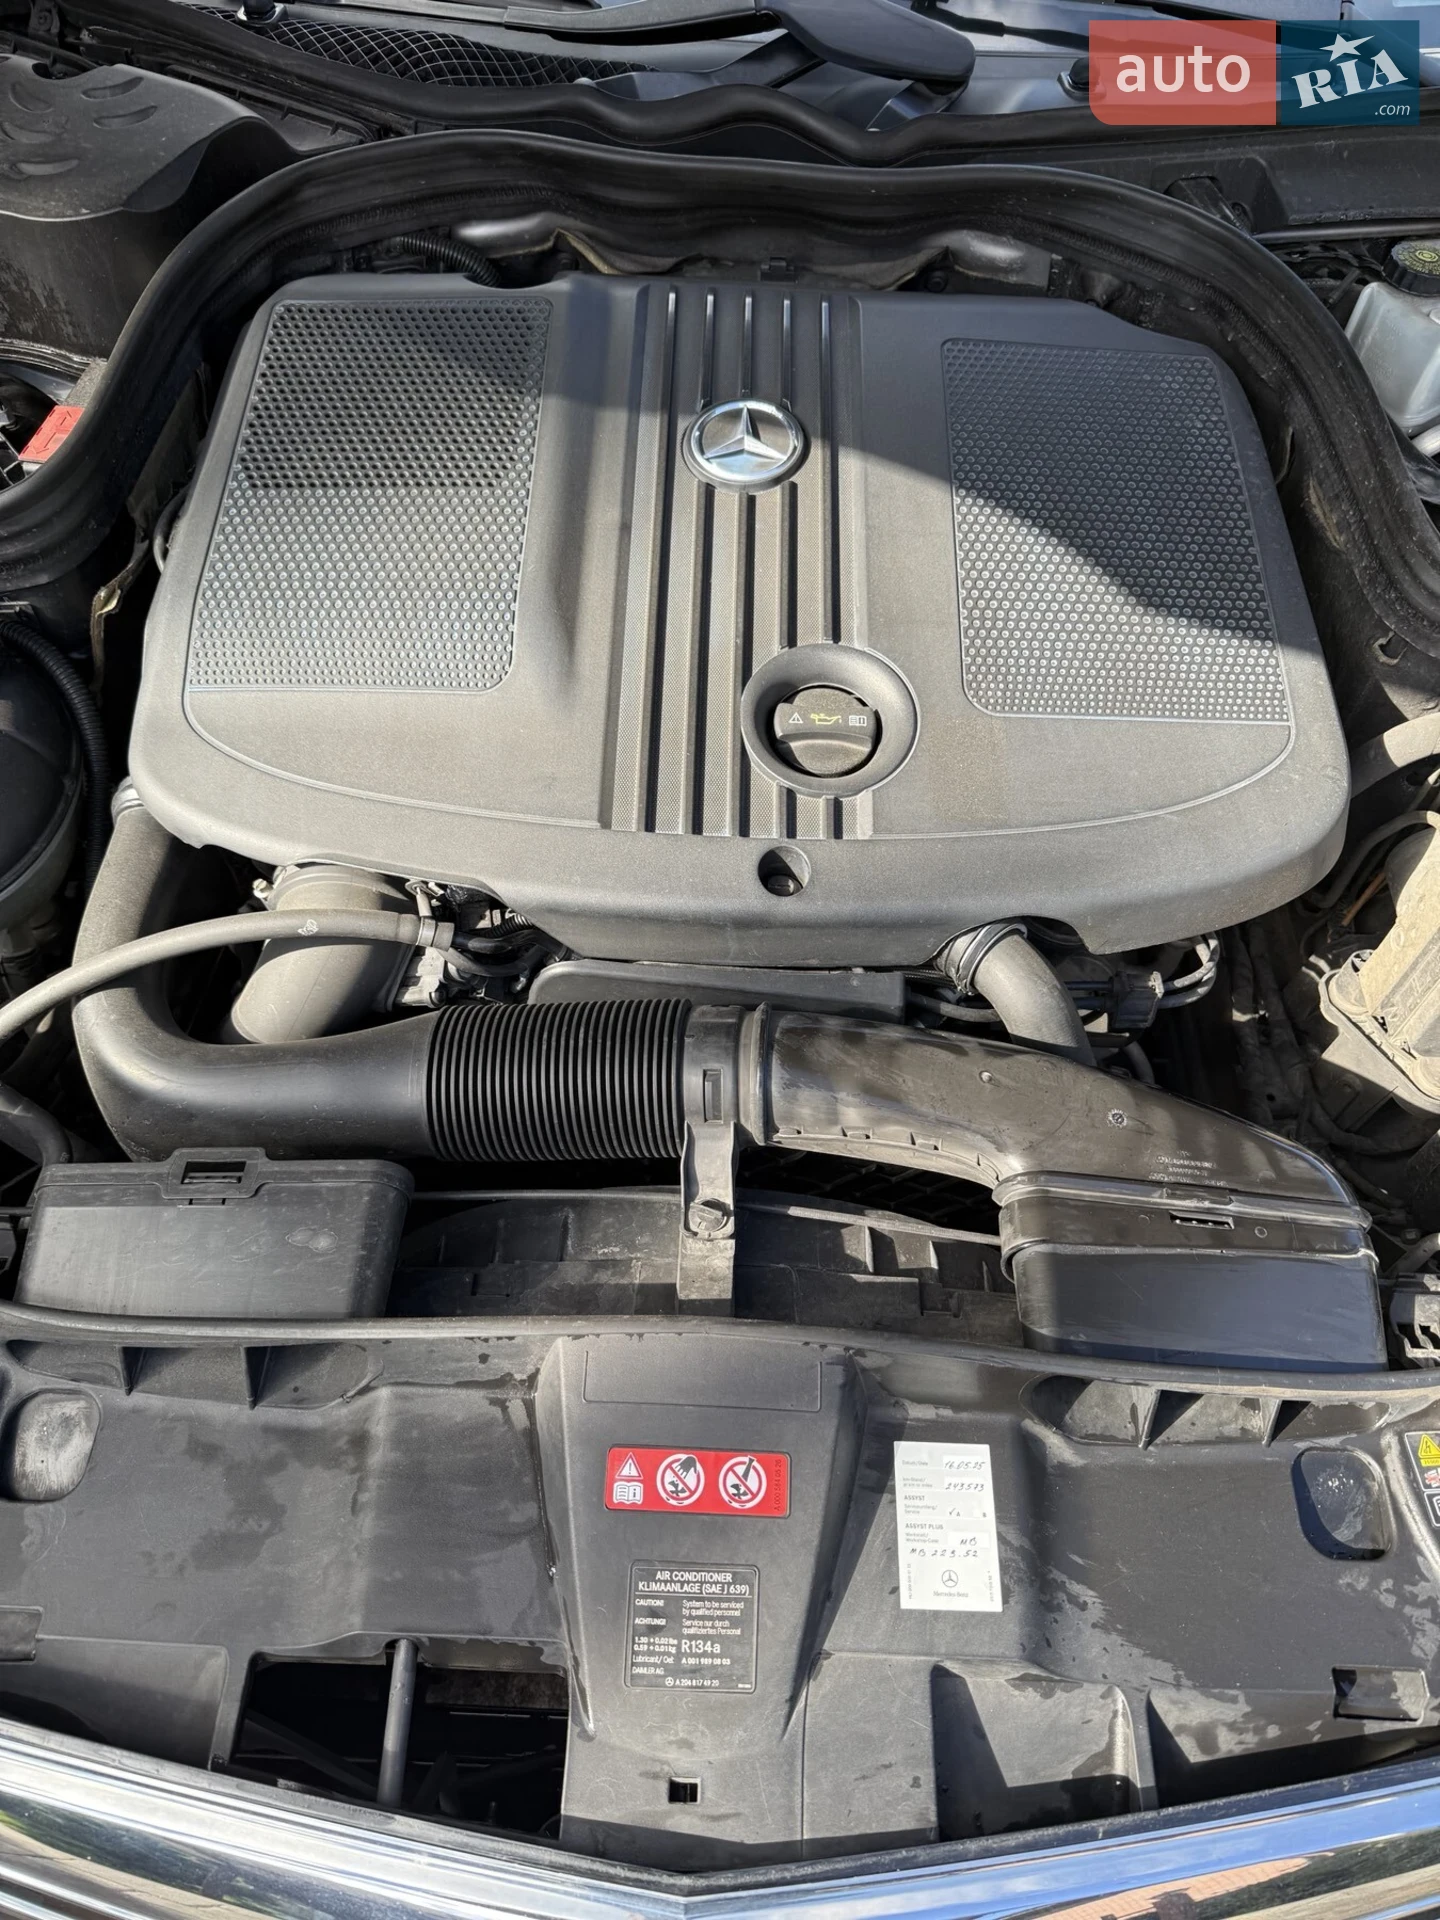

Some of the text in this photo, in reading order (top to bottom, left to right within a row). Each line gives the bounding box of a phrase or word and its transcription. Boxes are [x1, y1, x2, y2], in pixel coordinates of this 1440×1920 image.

[655, 1571, 733, 1582] AIR CONDITIONER
[638, 1581, 750, 1597] KLIMAANLAGE (SAE J 639)
[682, 1600, 704, 1608] System
[720, 1601, 744, 1609] serviced
[682, 1608, 741, 1617] by qualified personnel
[682, 1619, 703, 1627] Service
[714, 1620, 730, 1628] durch
[682, 1627, 717, 1635] qualifiziertes
[655, 1637, 669, 1645] 0.02
[681, 1639, 721, 1654] R134a
[632, 1655, 662, 1664] Lubricant/
[632, 1666, 665, 1675] DAIMLER AG
